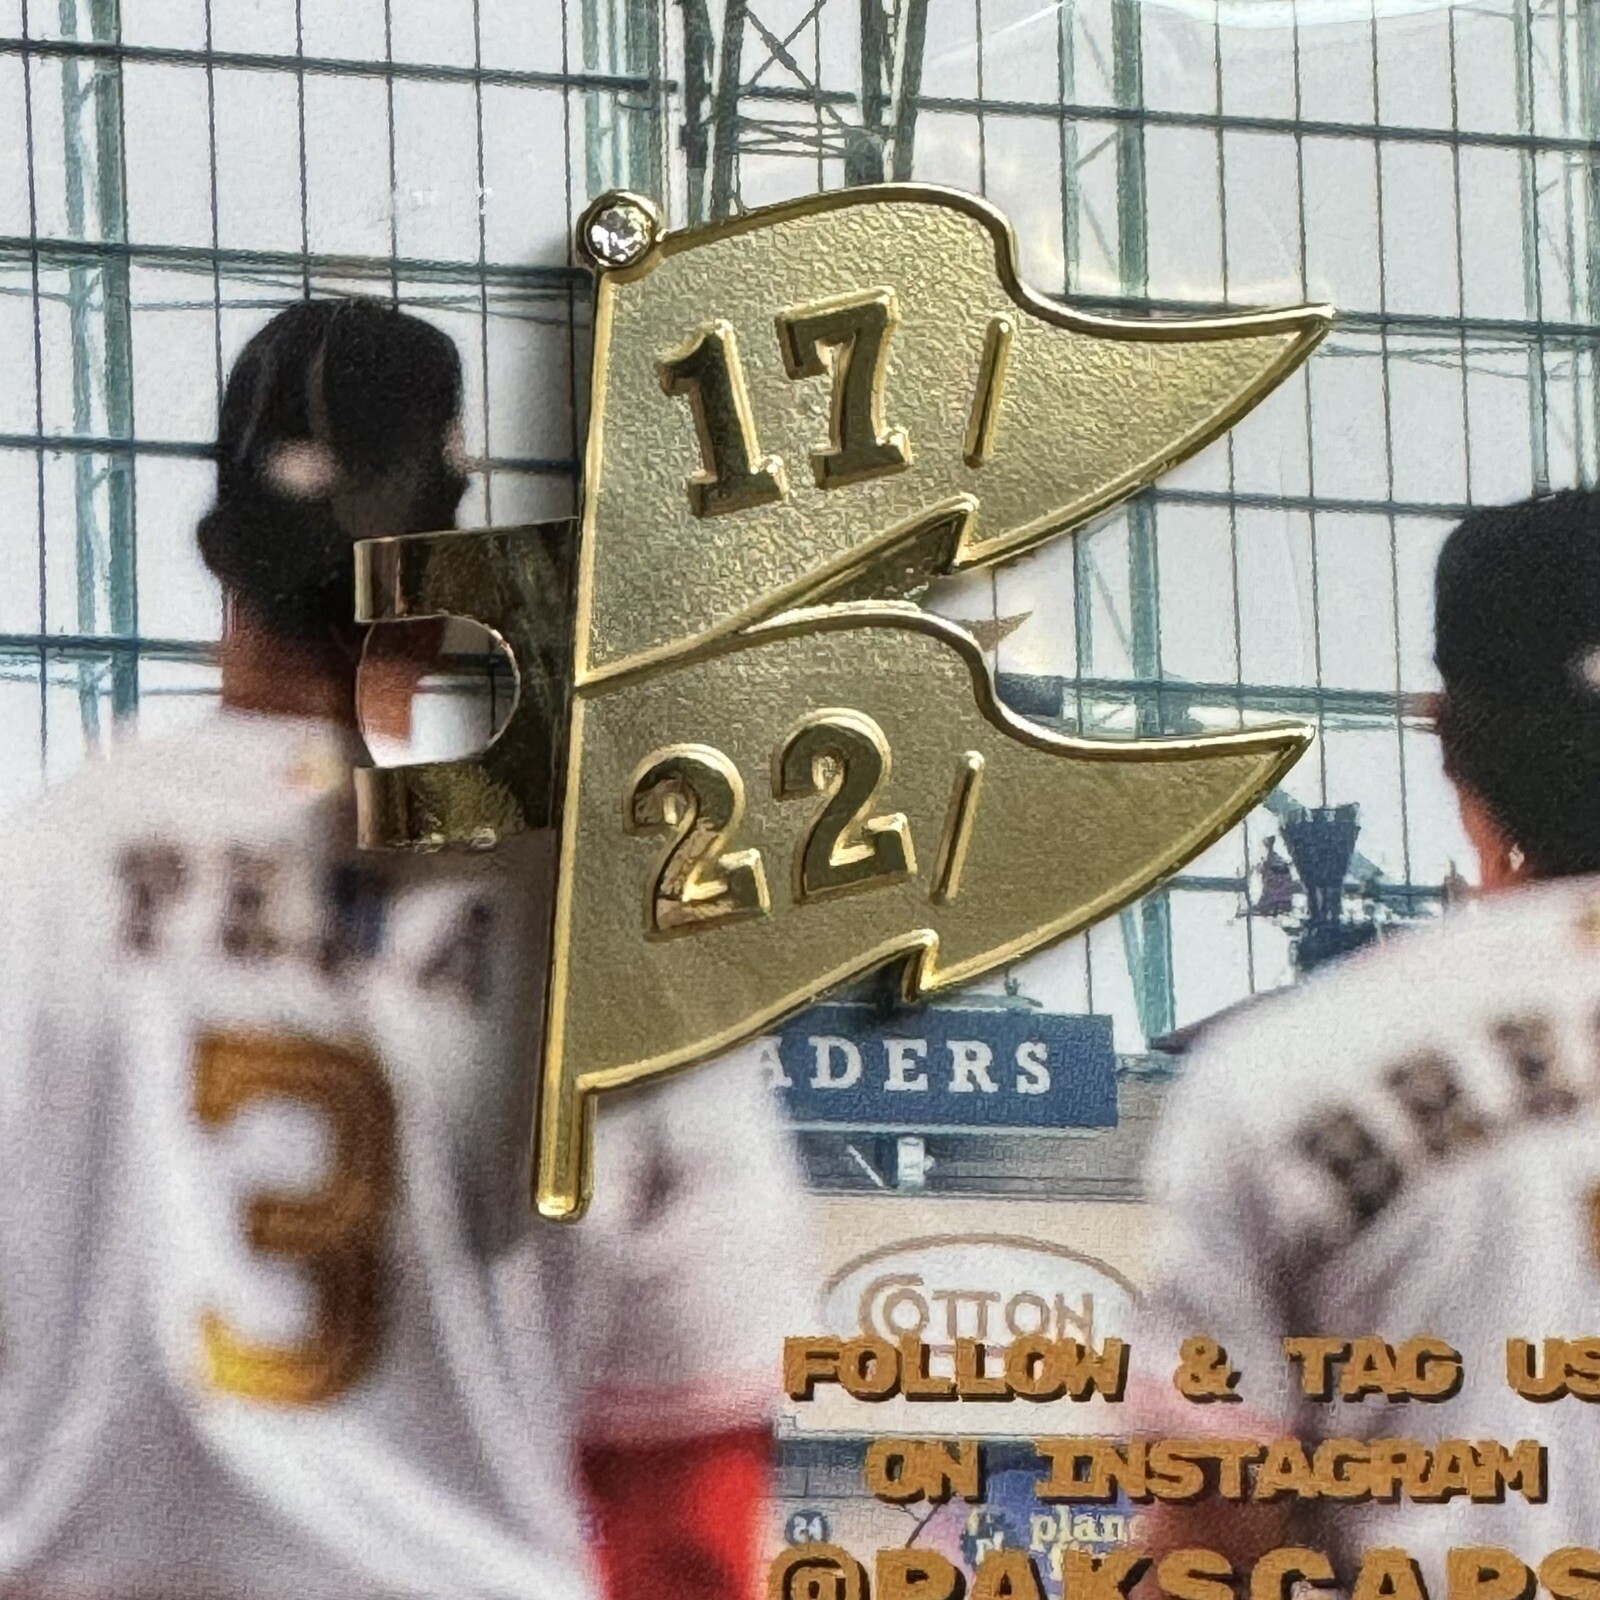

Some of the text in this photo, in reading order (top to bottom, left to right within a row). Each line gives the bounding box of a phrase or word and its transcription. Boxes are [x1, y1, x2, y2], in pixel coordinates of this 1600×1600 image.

[656, 286, 912, 518] 17
[623, 706, 918, 941] 22
[190, 1022, 398, 1410] 3
[783, 1332, 1600, 1404] FOLLOW & TAG US
[858, 1272, 1096, 1347] COTTON
[865, 1436, 1549, 1505] ON INSTAGRAM
